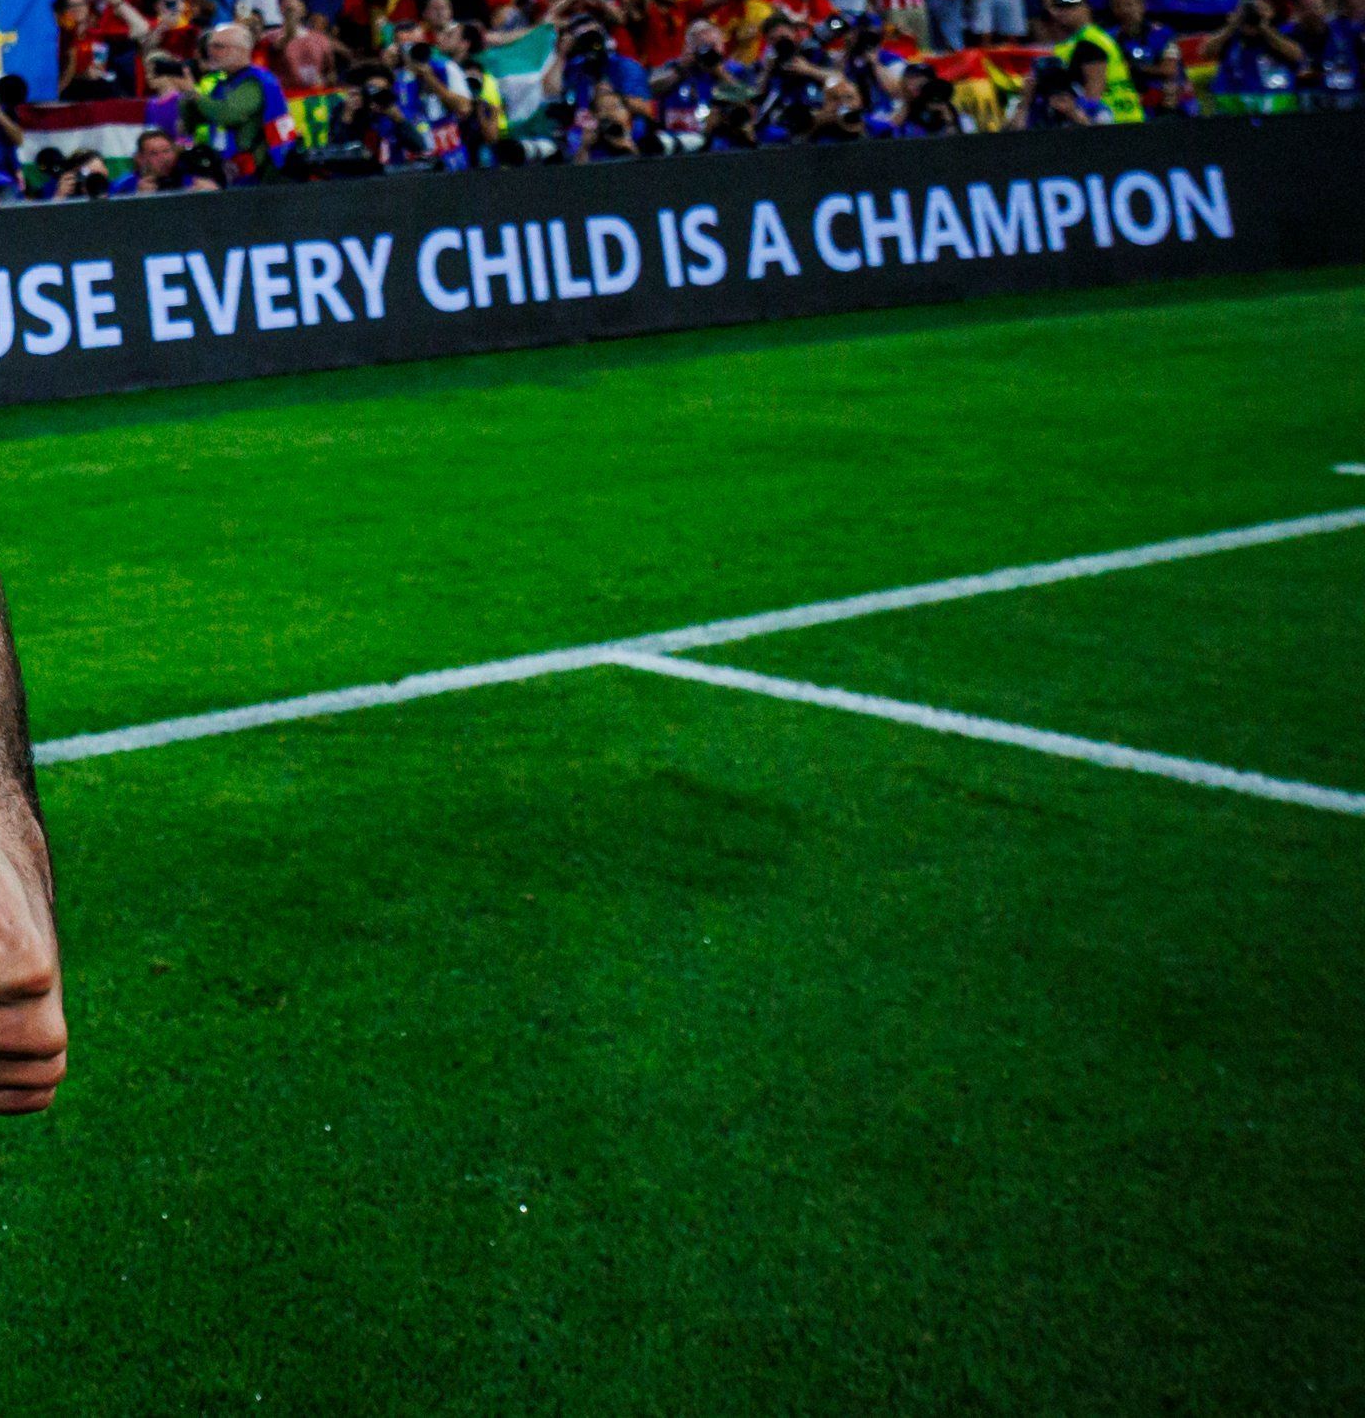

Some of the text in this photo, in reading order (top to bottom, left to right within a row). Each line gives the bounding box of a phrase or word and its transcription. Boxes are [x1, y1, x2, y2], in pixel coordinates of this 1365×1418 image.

[145, 233, 393, 344] EVERY
[417, 214, 642, 314] CHILD
[657, 204, 728, 288] IS
[748, 201, 801, 280] A
[812, 164, 1235, 273] CHAMPION
